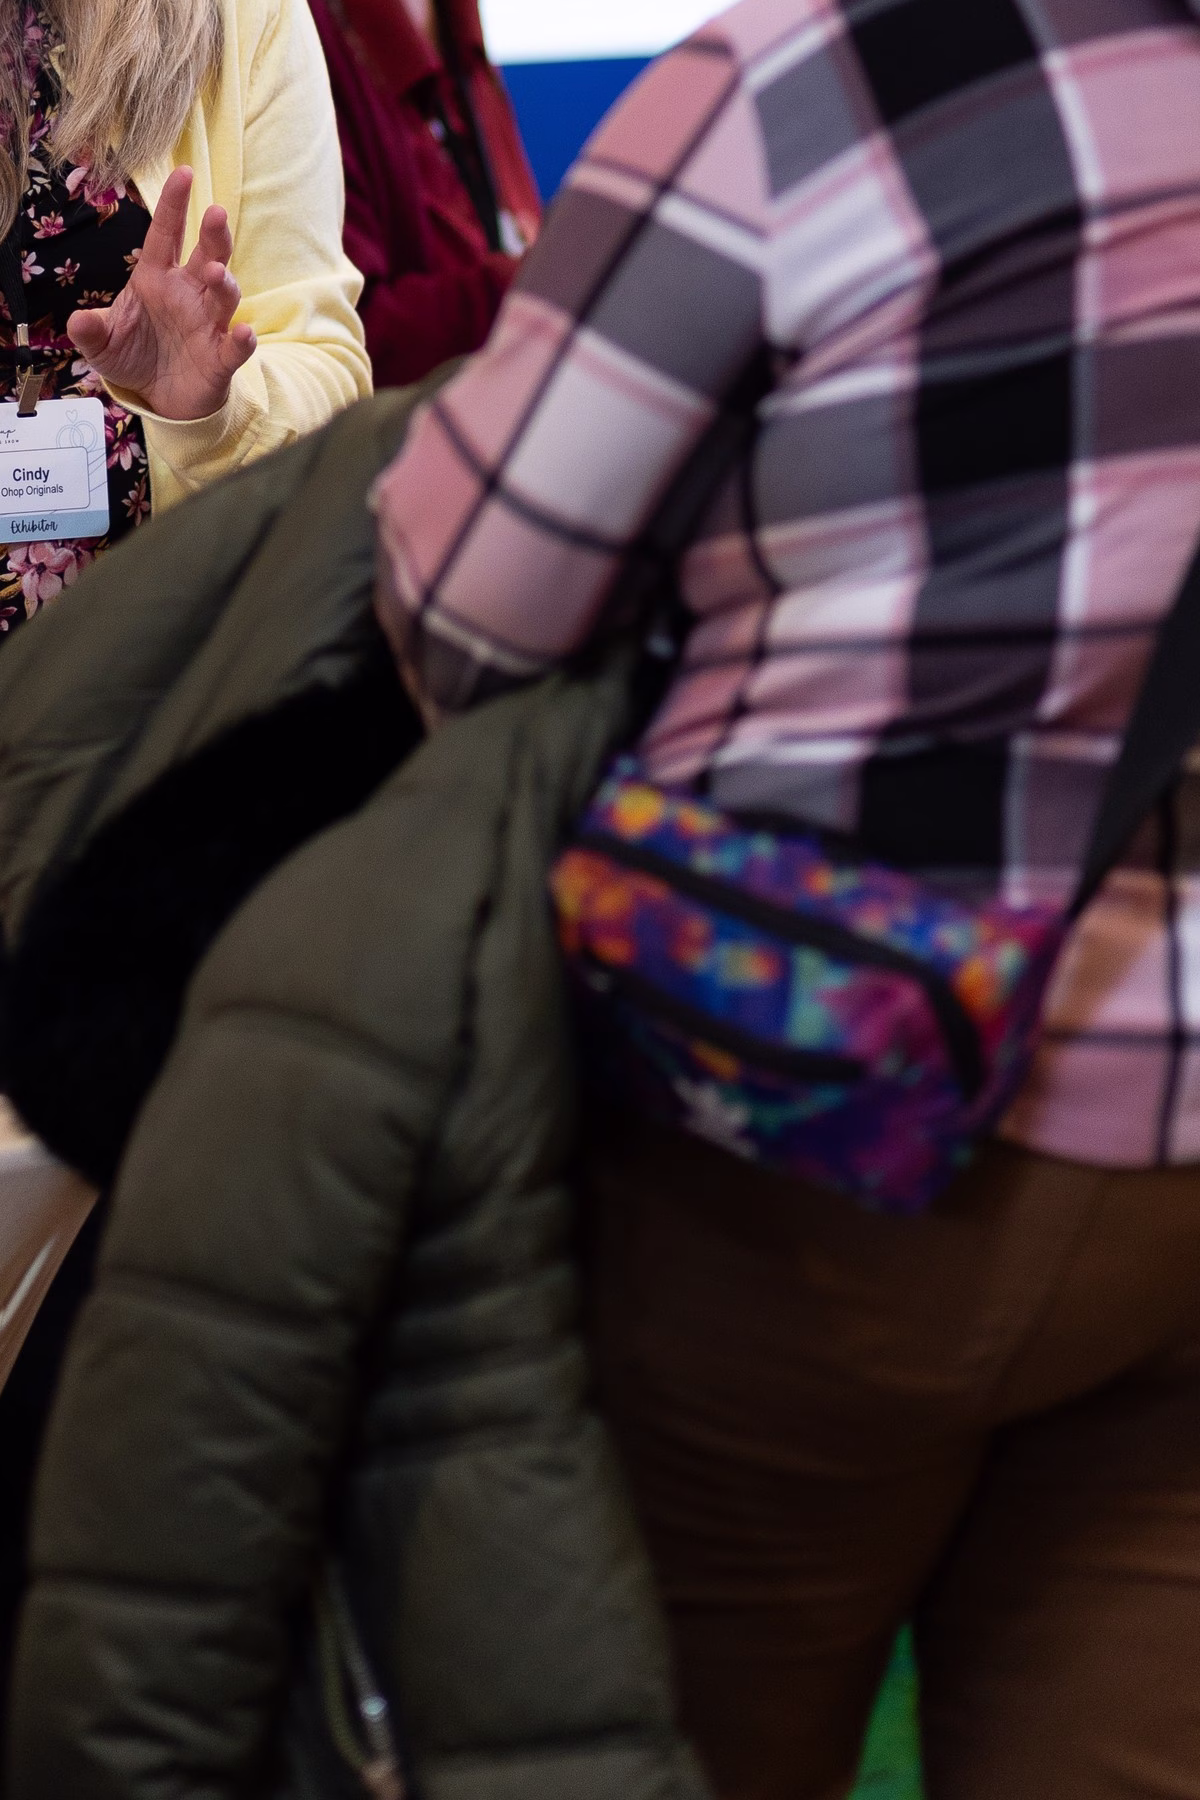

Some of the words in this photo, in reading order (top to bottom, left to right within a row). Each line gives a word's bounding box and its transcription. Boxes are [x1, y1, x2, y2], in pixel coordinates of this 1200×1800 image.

[12, 467, 50, 482] Cindy
[1, 486, 24, 498] Ohop
[26, 484, 64, 496] Originals
[10, 520, 58, 534] Exhibitor
